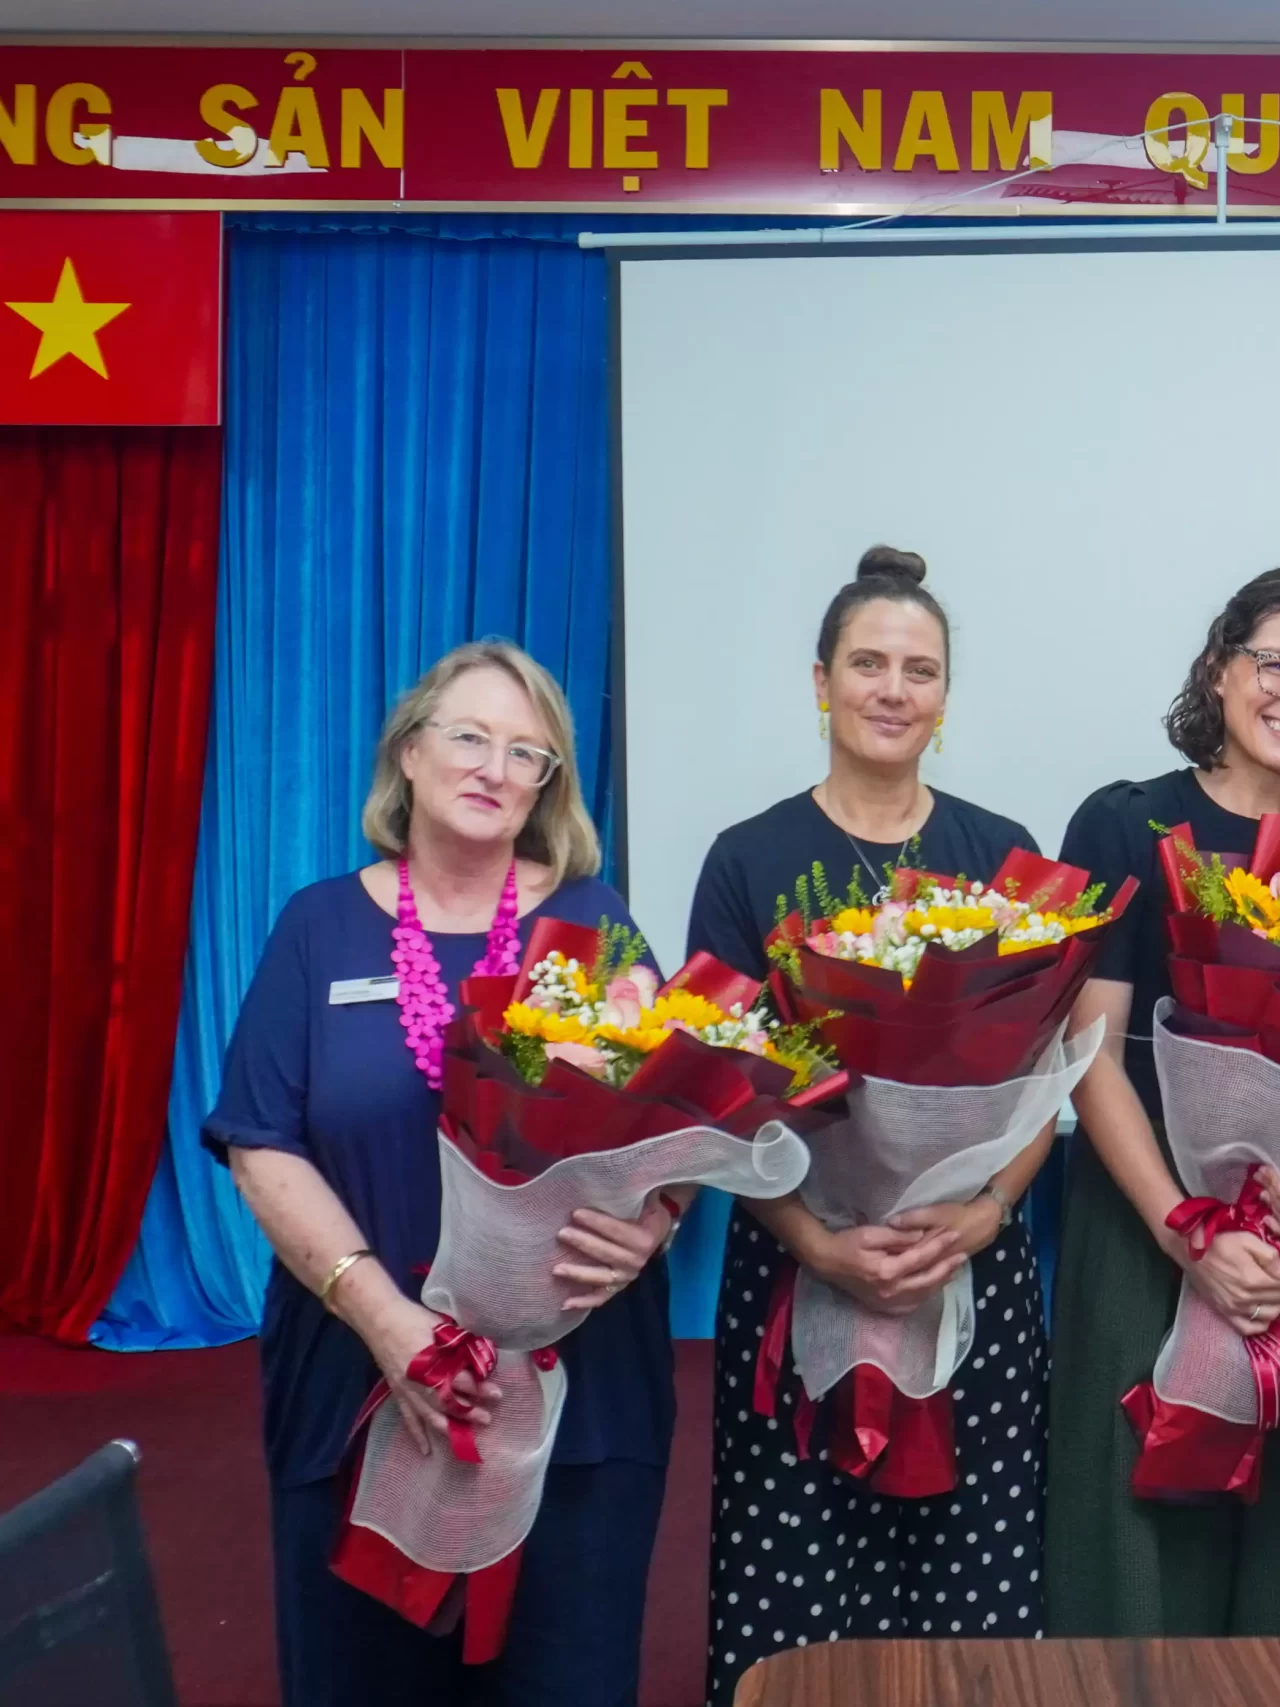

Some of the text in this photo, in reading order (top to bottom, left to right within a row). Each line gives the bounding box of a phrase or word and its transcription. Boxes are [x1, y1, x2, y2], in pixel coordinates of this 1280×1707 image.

[0, 82, 112, 166] NG
[194, 51, 404, 169] SẢN
[496, 61, 728, 191] VIỆT
[820, 88, 1053, 172] NAM
